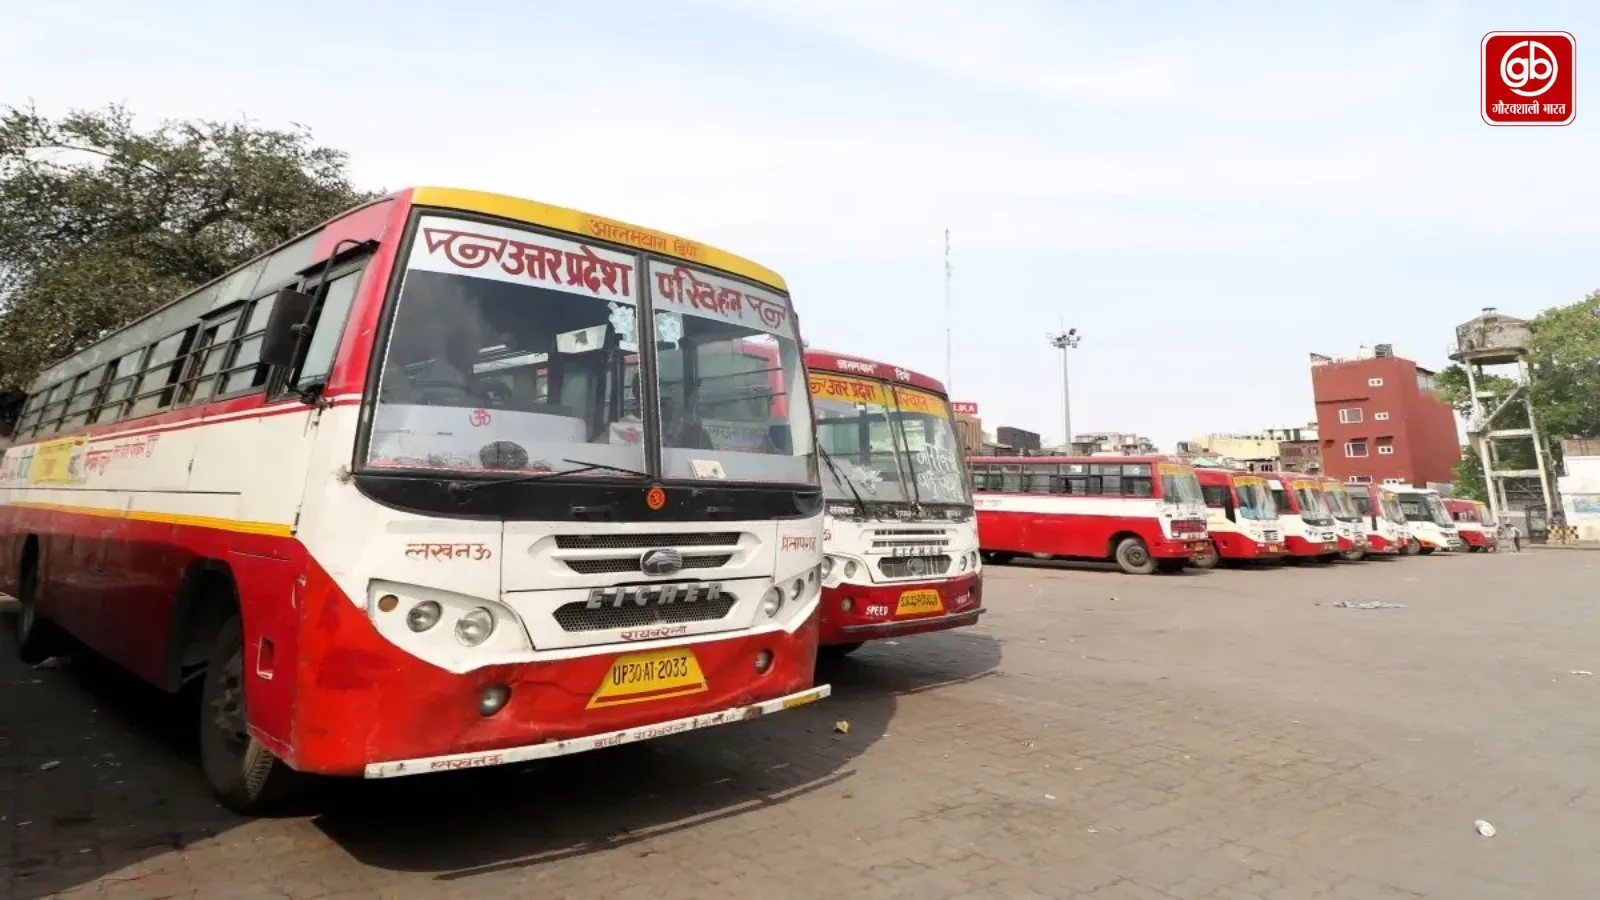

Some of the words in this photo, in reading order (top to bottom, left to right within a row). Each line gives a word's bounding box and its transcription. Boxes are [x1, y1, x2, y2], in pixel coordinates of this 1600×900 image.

[501, 240, 563, 284] उत्तर
[565, 244, 633, 297] प्रदेश
[405, 543, 492, 563] लखनऊ
[586, 583, 723, 609] EICHER
